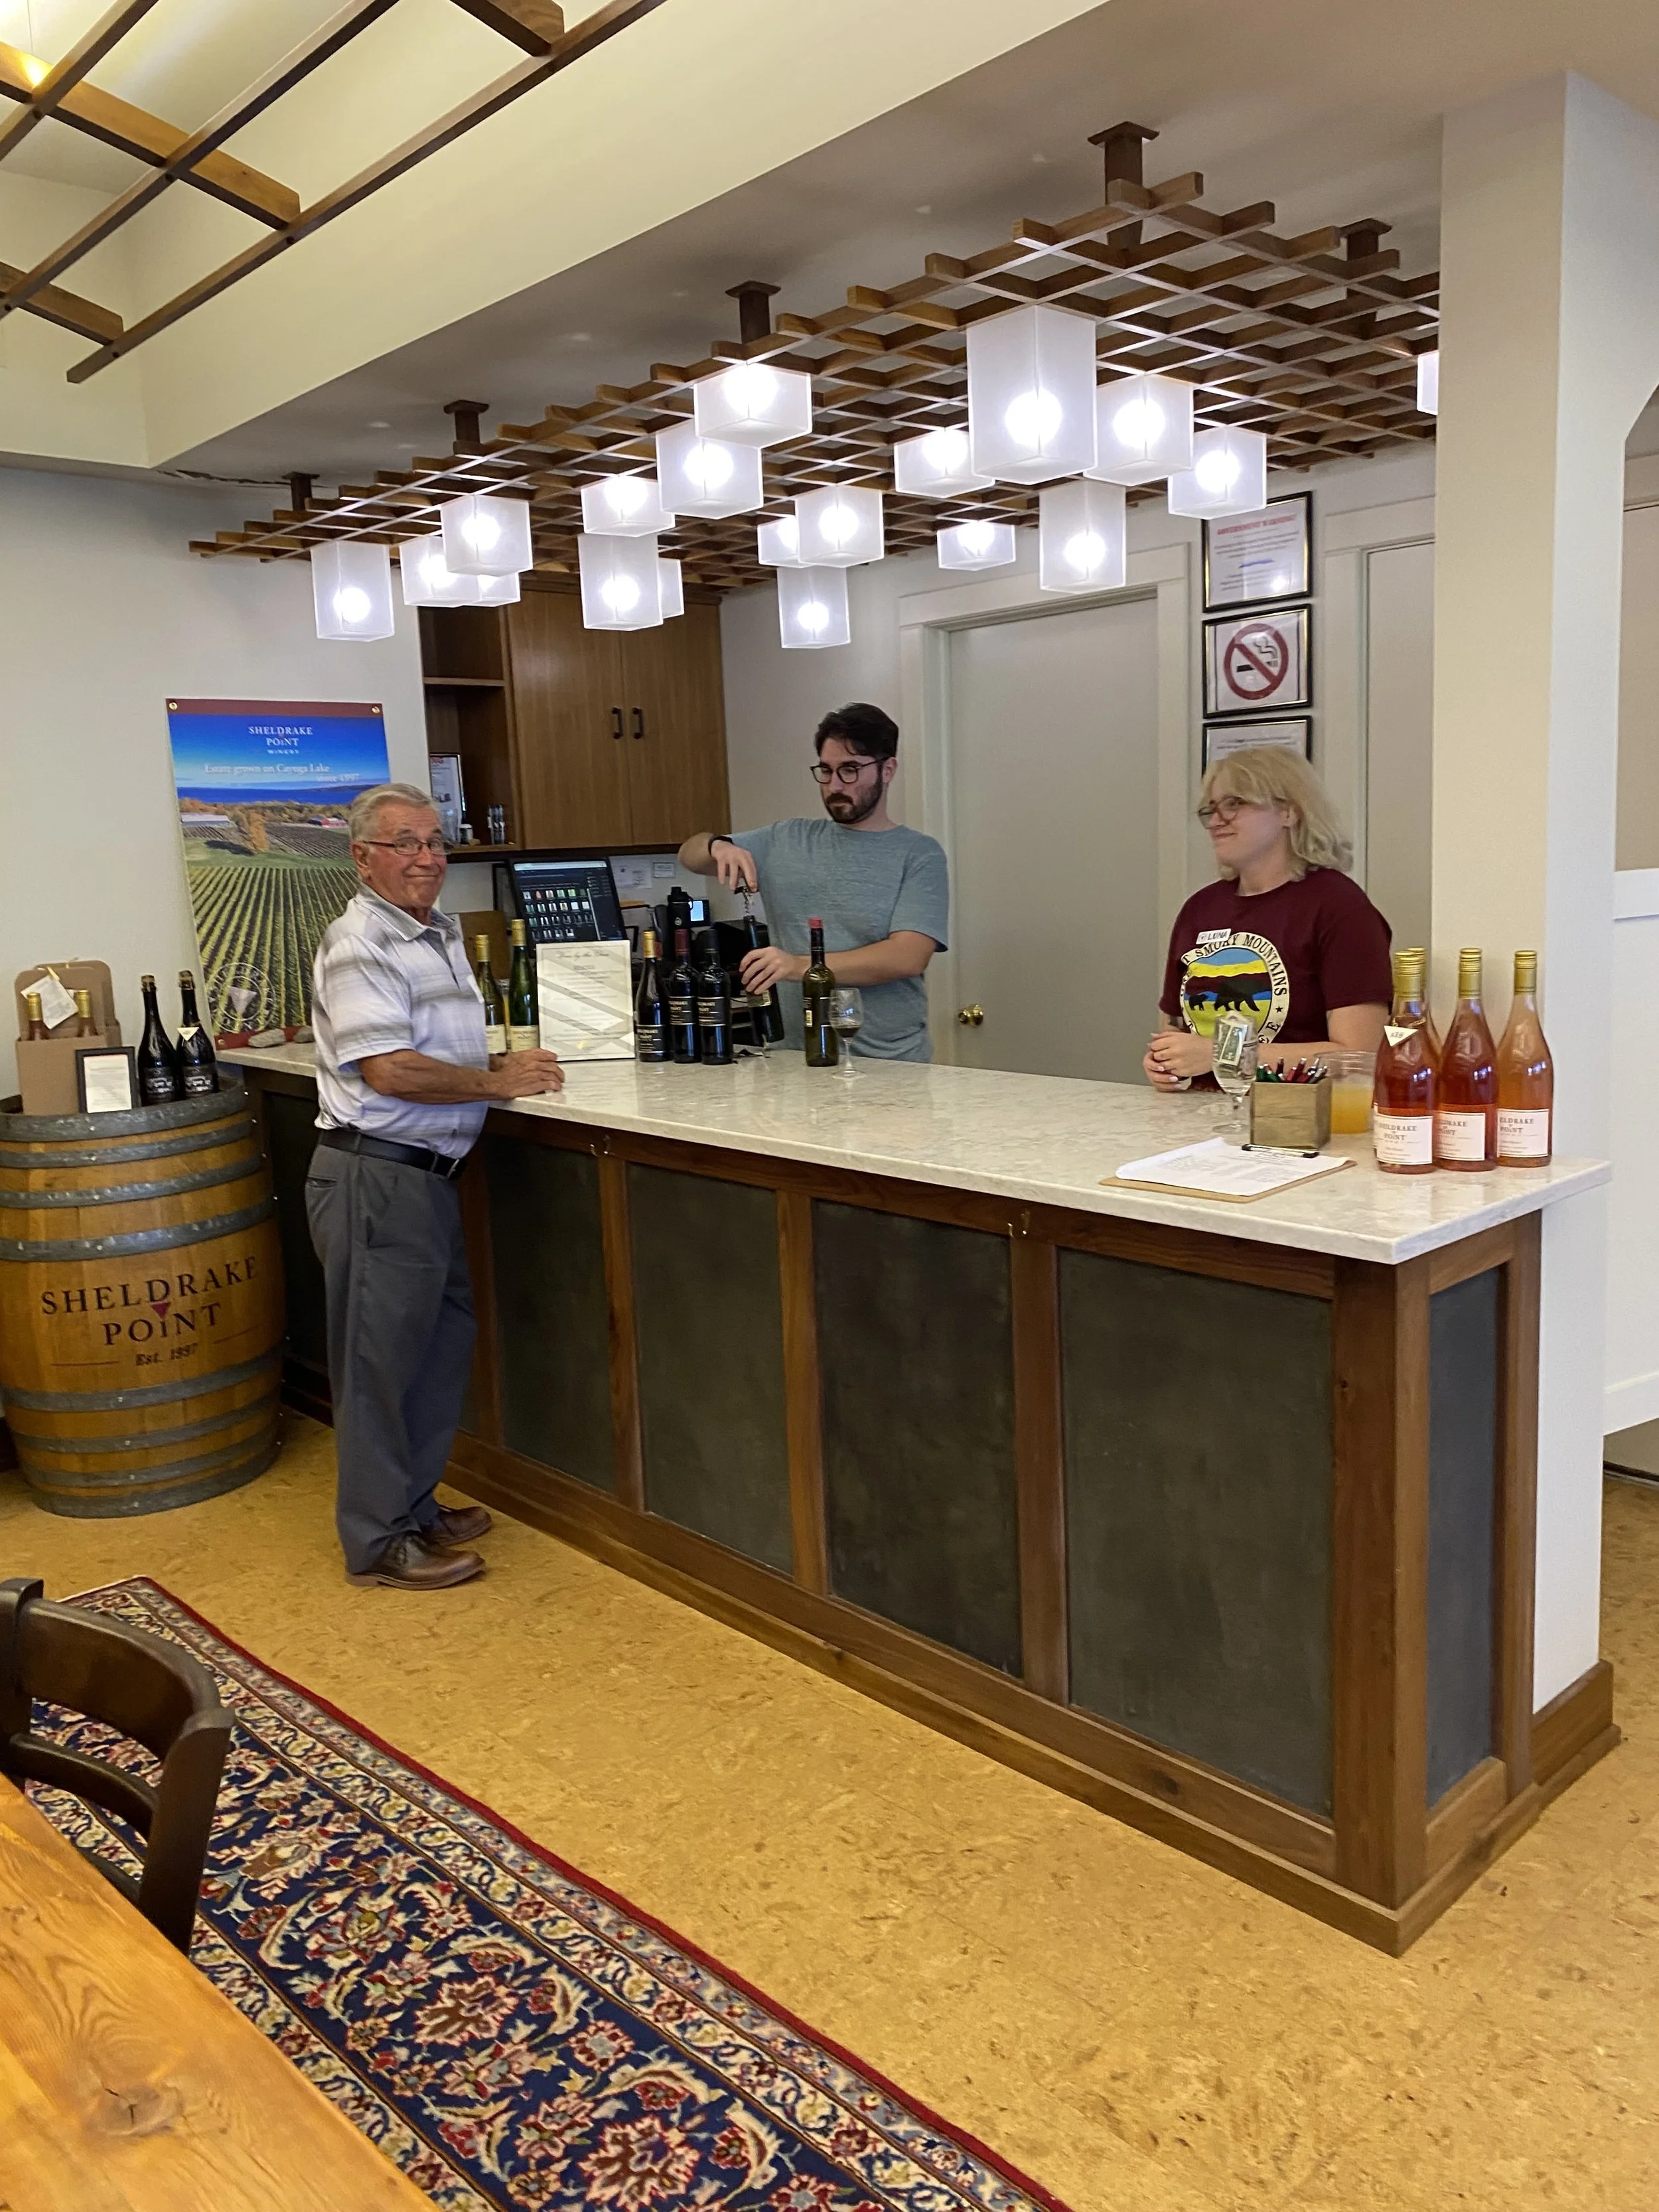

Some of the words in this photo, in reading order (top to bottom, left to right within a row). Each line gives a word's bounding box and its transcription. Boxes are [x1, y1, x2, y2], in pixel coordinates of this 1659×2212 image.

[248, 726, 313, 735] SHELDRAKE
[266, 737, 299, 746] POINT
[234, 765, 261, 775] grown
[309, 764, 330, 773] Lake
[1242, 934, 1287, 996] MOUNTAINS
[41, 1256, 258, 1315] SHELDRAKE
[102, 1302, 222, 1346] POINT
